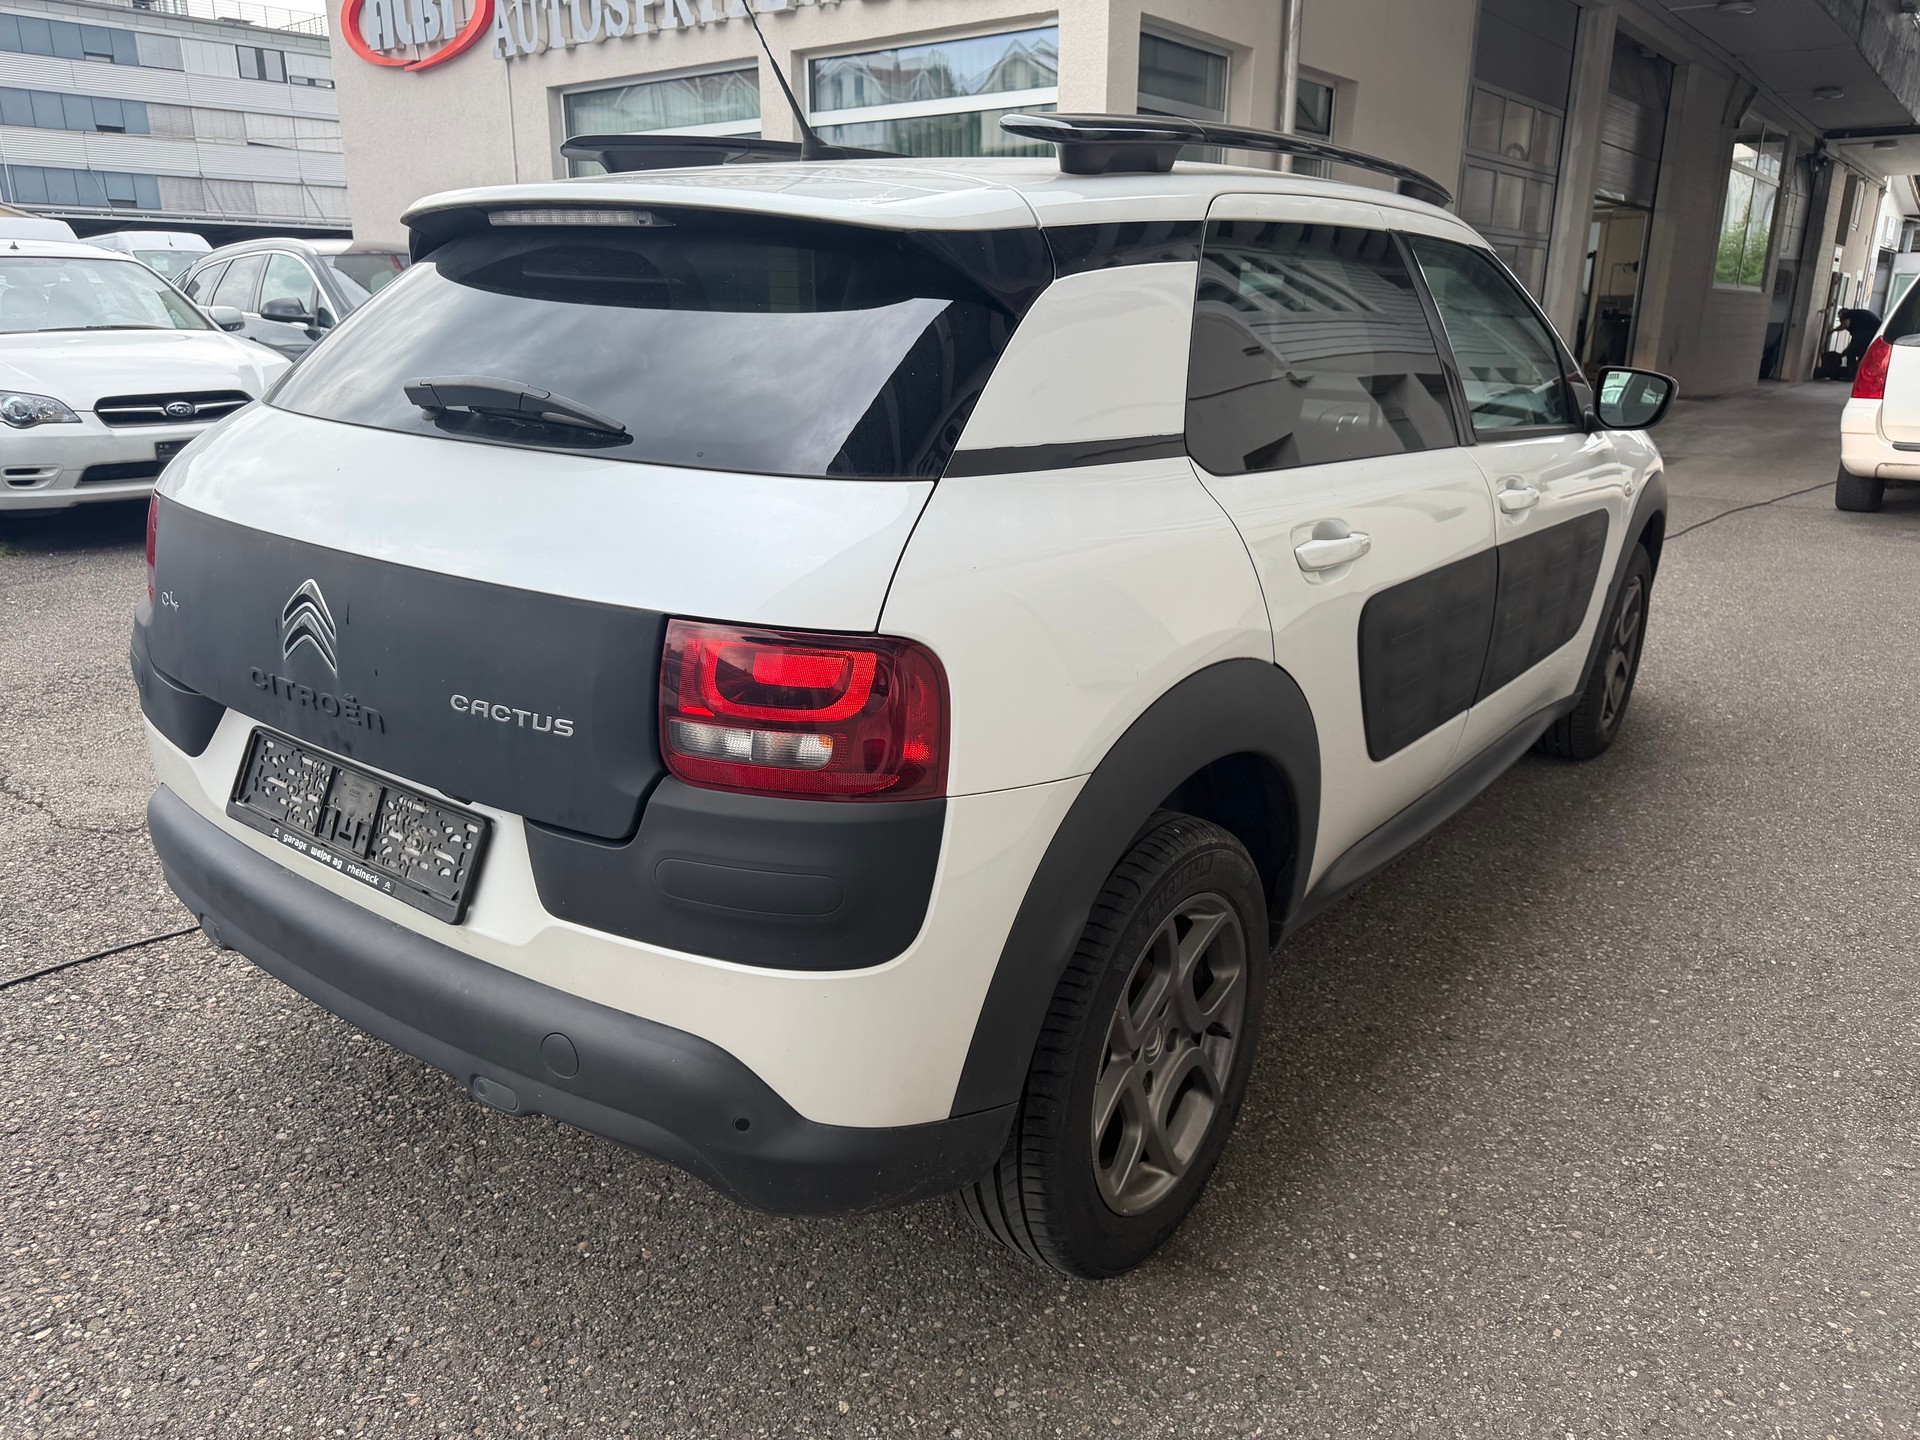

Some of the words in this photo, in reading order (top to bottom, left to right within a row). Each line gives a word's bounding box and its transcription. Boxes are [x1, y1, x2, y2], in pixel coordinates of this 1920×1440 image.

[161, 590, 180, 613] C4
[450, 694, 574, 737] CACTUS
[282, 833, 308, 850] garage
[332, 857, 343, 869] ag
[346, 864, 380, 885] rheineck
